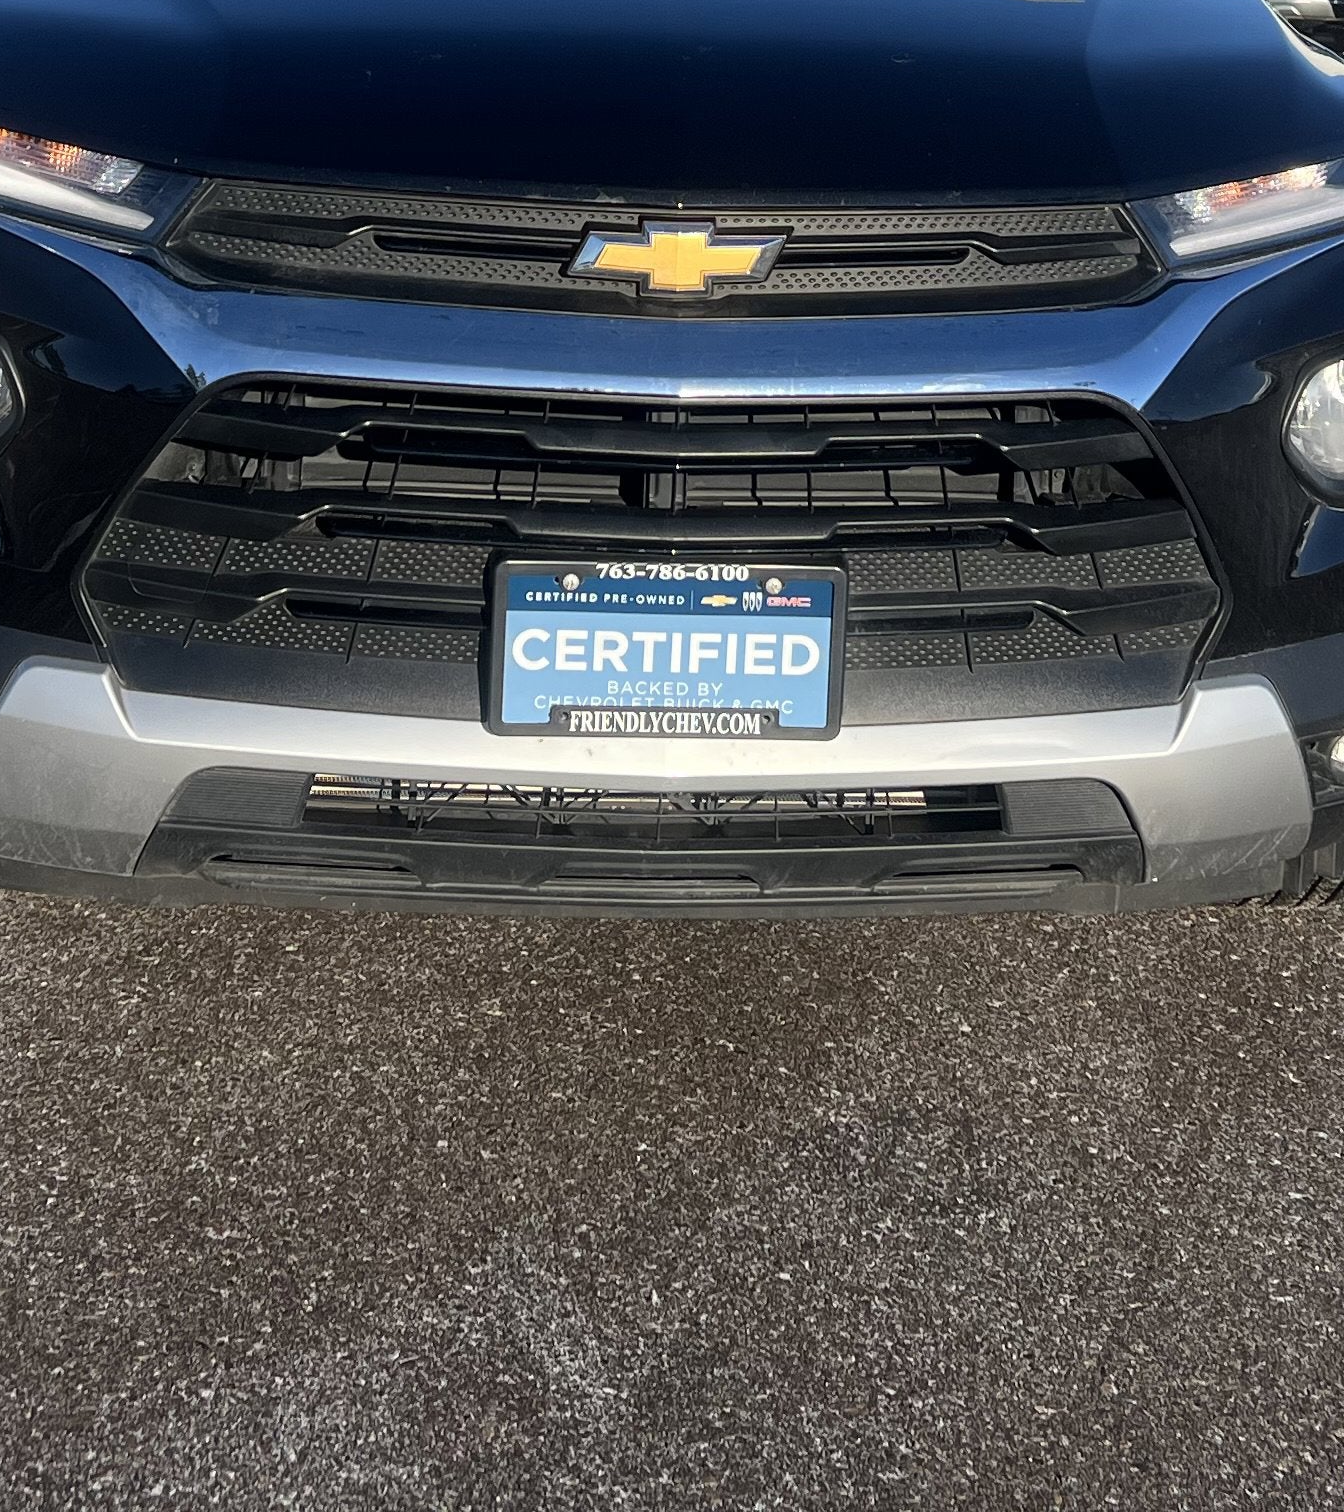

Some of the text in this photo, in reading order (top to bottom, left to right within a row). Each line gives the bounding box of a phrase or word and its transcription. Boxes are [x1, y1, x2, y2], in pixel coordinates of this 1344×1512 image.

[595, 563, 750, 581] 763-786-6100
[524, 591, 812, 607] CERTIFIED PRE-OWNED GMC
[511, 628, 821, 675] CERTIFIED
[607, 680, 724, 697] BACKED BY
[568, 710, 761, 735] FRIENDLYCHEV.COM
